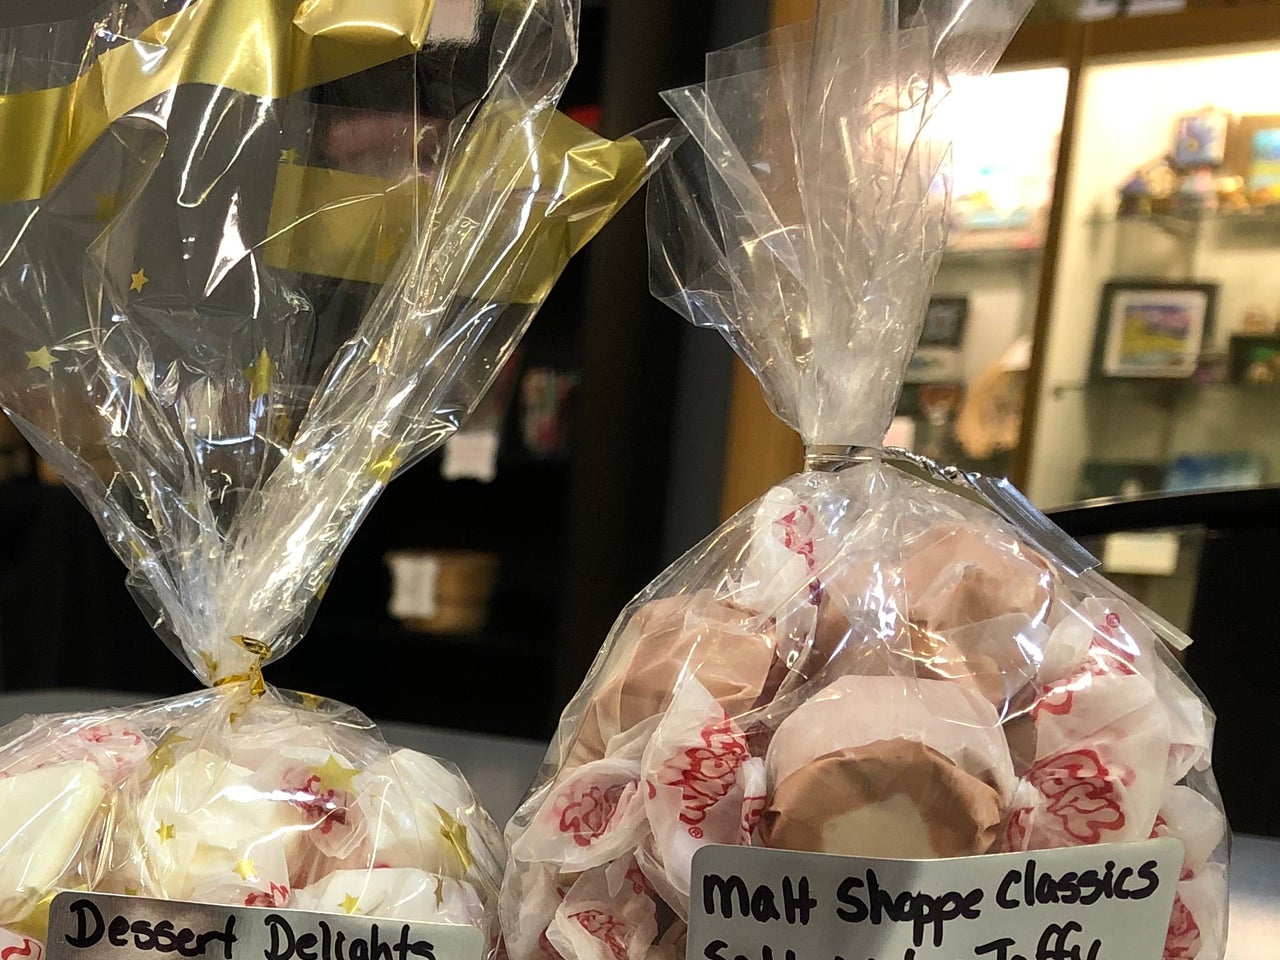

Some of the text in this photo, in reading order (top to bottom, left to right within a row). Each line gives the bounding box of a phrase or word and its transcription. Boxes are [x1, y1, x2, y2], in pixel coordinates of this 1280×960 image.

[65, 899, 238, 960] Dessert
[836, 868, 983, 947] Shoppe
[996, 860, 1160, 909] Classics
